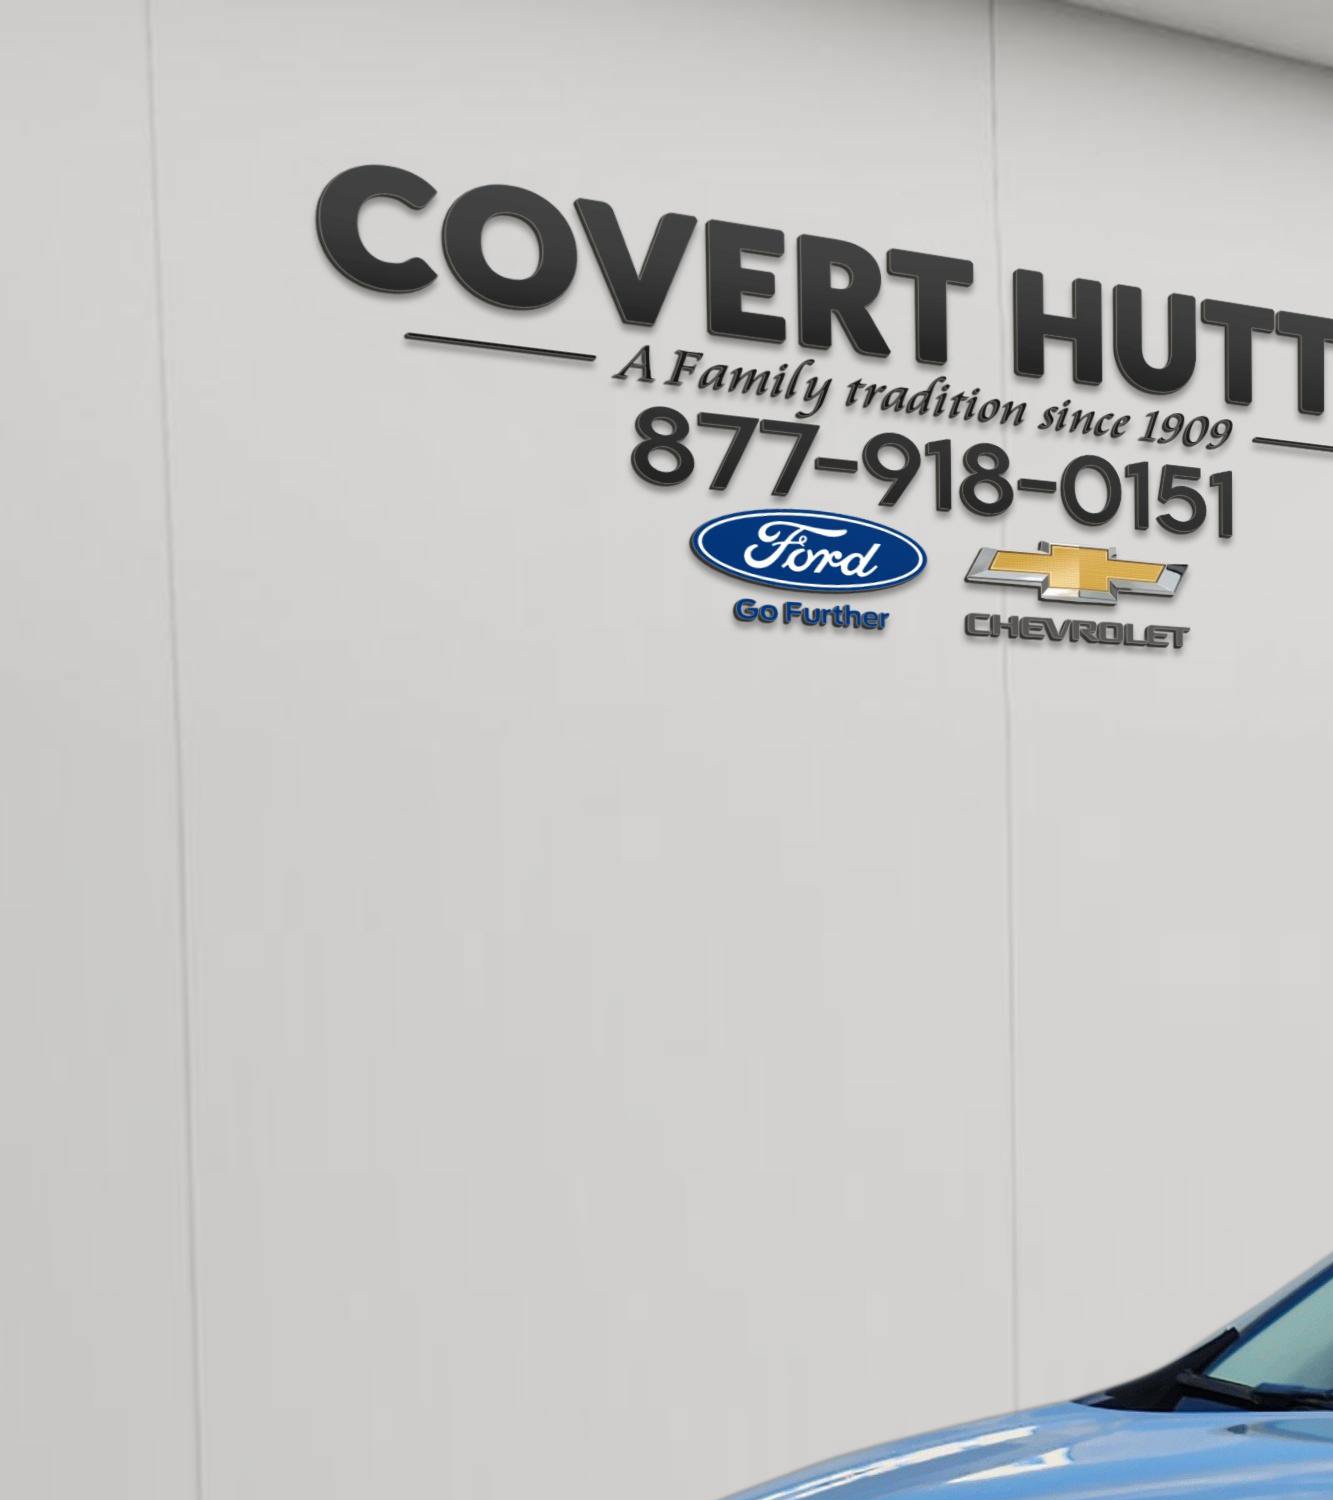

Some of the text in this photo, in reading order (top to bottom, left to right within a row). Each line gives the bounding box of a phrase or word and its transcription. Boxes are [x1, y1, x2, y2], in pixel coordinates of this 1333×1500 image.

[316, 164, 974, 365] COVERT
[613, 345, 1233, 450] A Family tradition since 1909
[630, 406, 1233, 539] 877-918-0151
[743, 522, 881, 578] Ford
[733, 598, 890, 631] Go Further
[963, 612, 1190, 650] CHEVROLET
